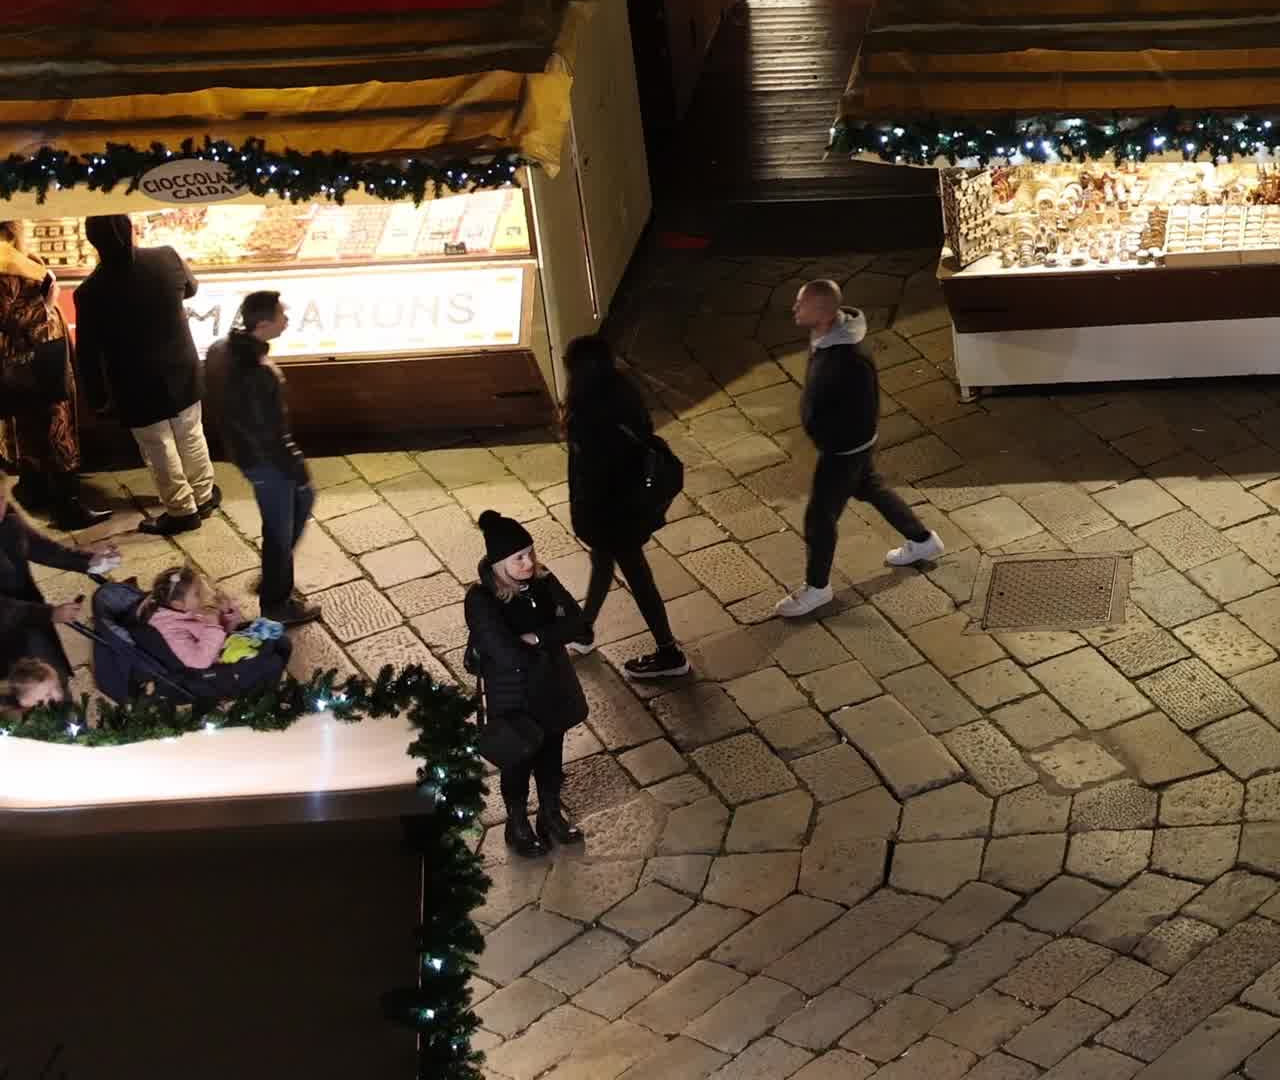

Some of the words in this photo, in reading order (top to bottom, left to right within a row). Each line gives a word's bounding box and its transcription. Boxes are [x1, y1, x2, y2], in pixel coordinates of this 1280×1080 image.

[143, 172, 236, 193] CIOCCOLA
[172, 185, 234, 199] CALDA
[186, 292, 476, 336] MAARONS
